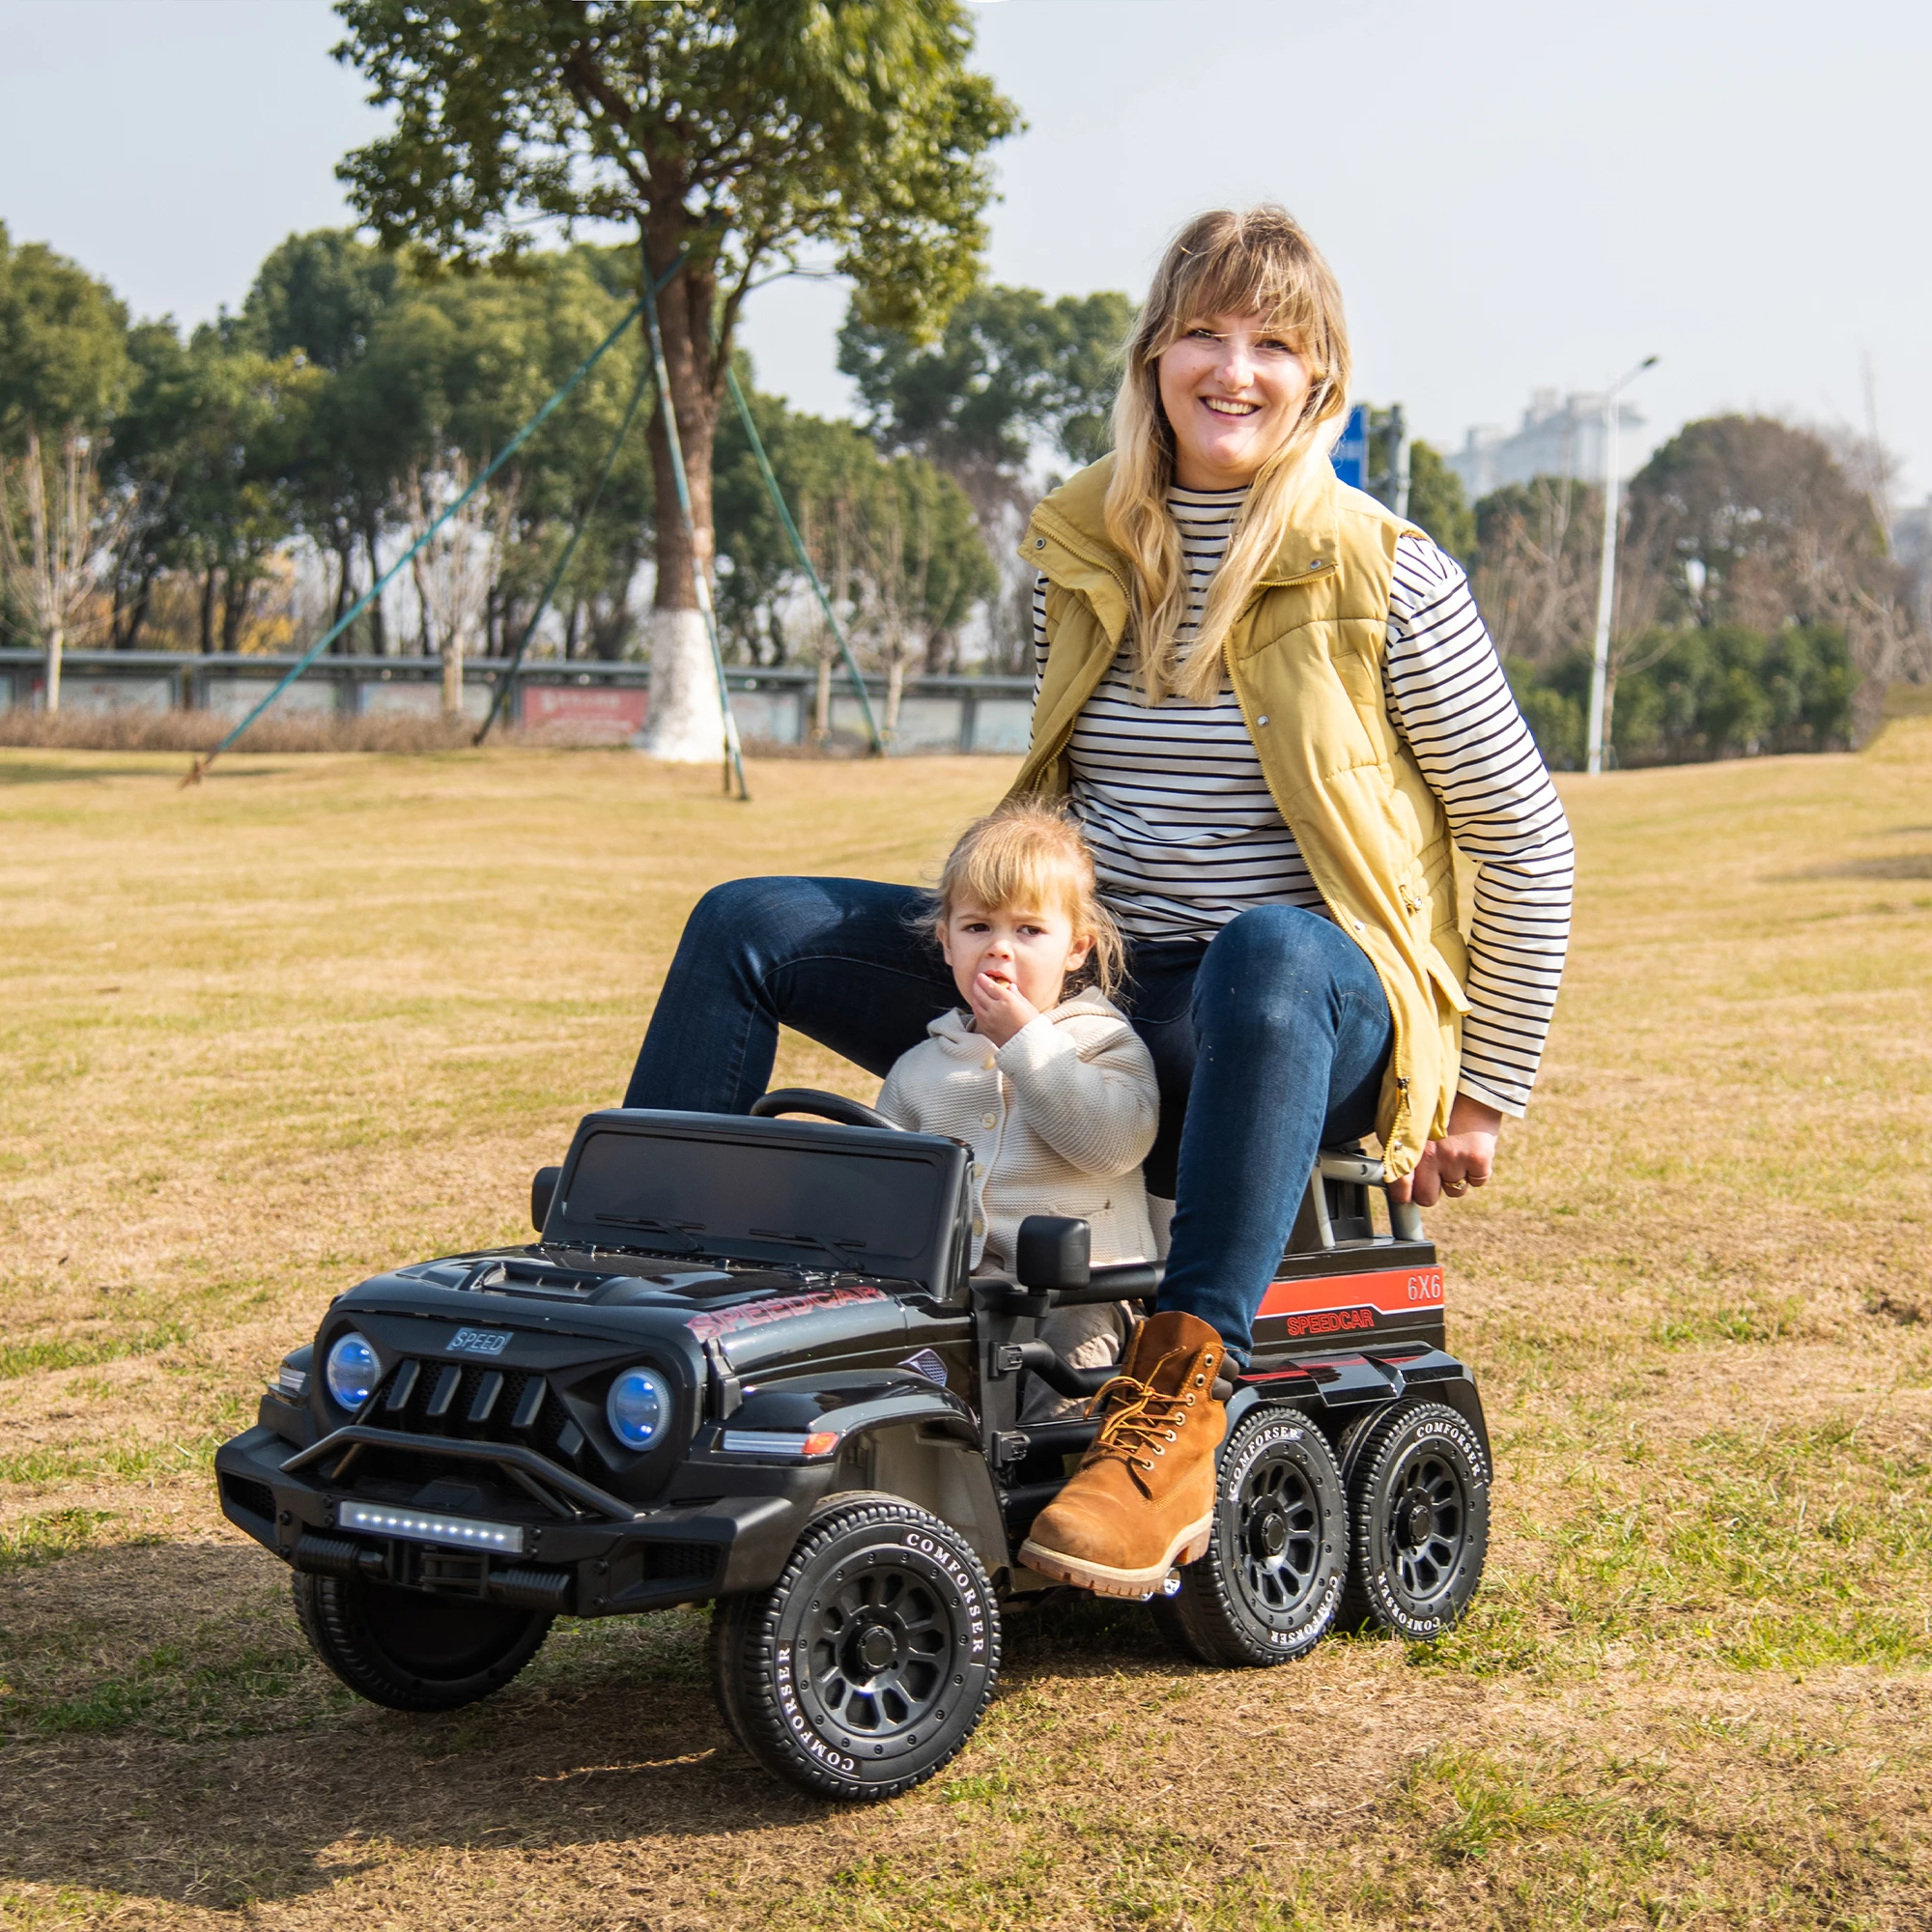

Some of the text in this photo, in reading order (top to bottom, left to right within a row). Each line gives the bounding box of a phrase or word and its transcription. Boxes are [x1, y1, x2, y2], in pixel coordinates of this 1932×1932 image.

[685, 1286, 888, 1339] SPEEDCAR
[1407, 1274, 1441, 1301] 6X6
[451, 1331, 506, 1350] SPEED
[1287, 1309, 1375, 1336] SPEEDCAR
[1229, 1426, 1301, 1494] COMFORSER
[1416, 1422, 1481, 1477] COMFORSER
[906, 1532, 985, 1653] COMFORSER
[1270, 1576, 1338, 1644] COMFORSER
[1378, 1571, 1441, 1632] COMFORSER
[778, 1647, 856, 1773] COMFORSER
